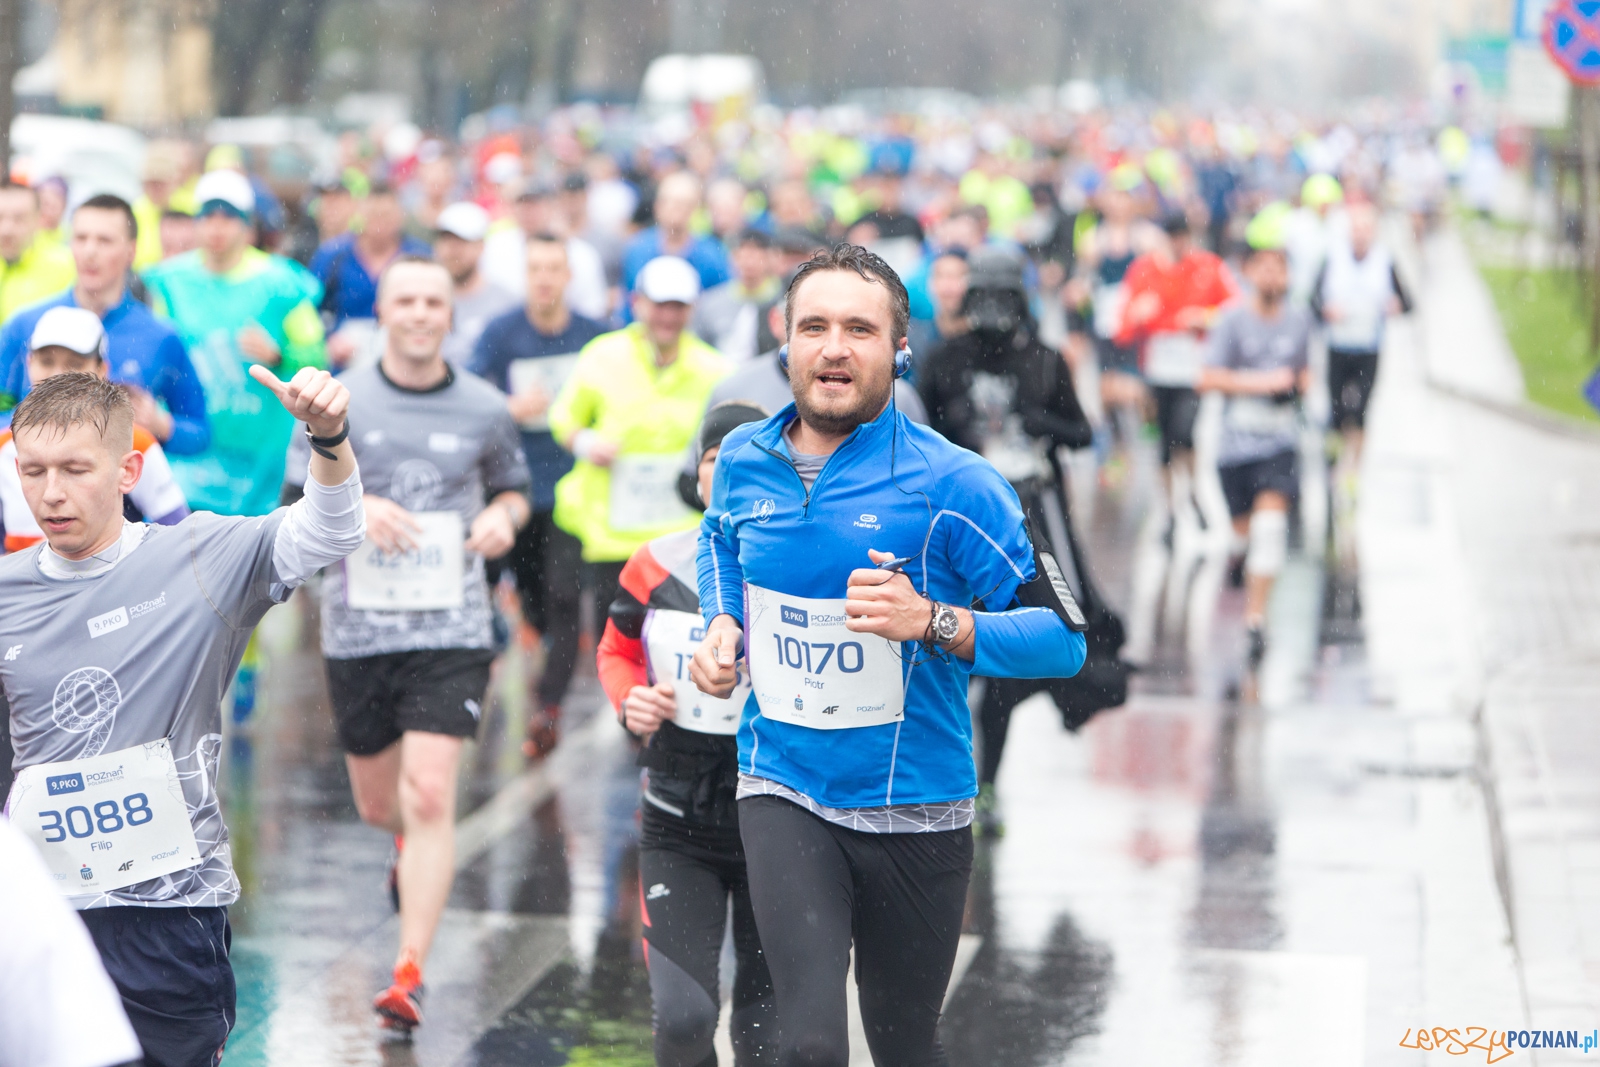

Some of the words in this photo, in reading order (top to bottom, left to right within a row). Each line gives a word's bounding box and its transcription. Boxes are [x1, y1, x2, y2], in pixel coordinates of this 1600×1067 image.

[4, 644, 23, 661] 4F
[773, 633, 864, 675] 10170
[804, 677, 825, 689] Piotr
[822, 705, 839, 715] 4F
[38, 793, 153, 842] 3088
[91, 840, 113, 852] Filip
[118, 860, 134, 871] 4F
